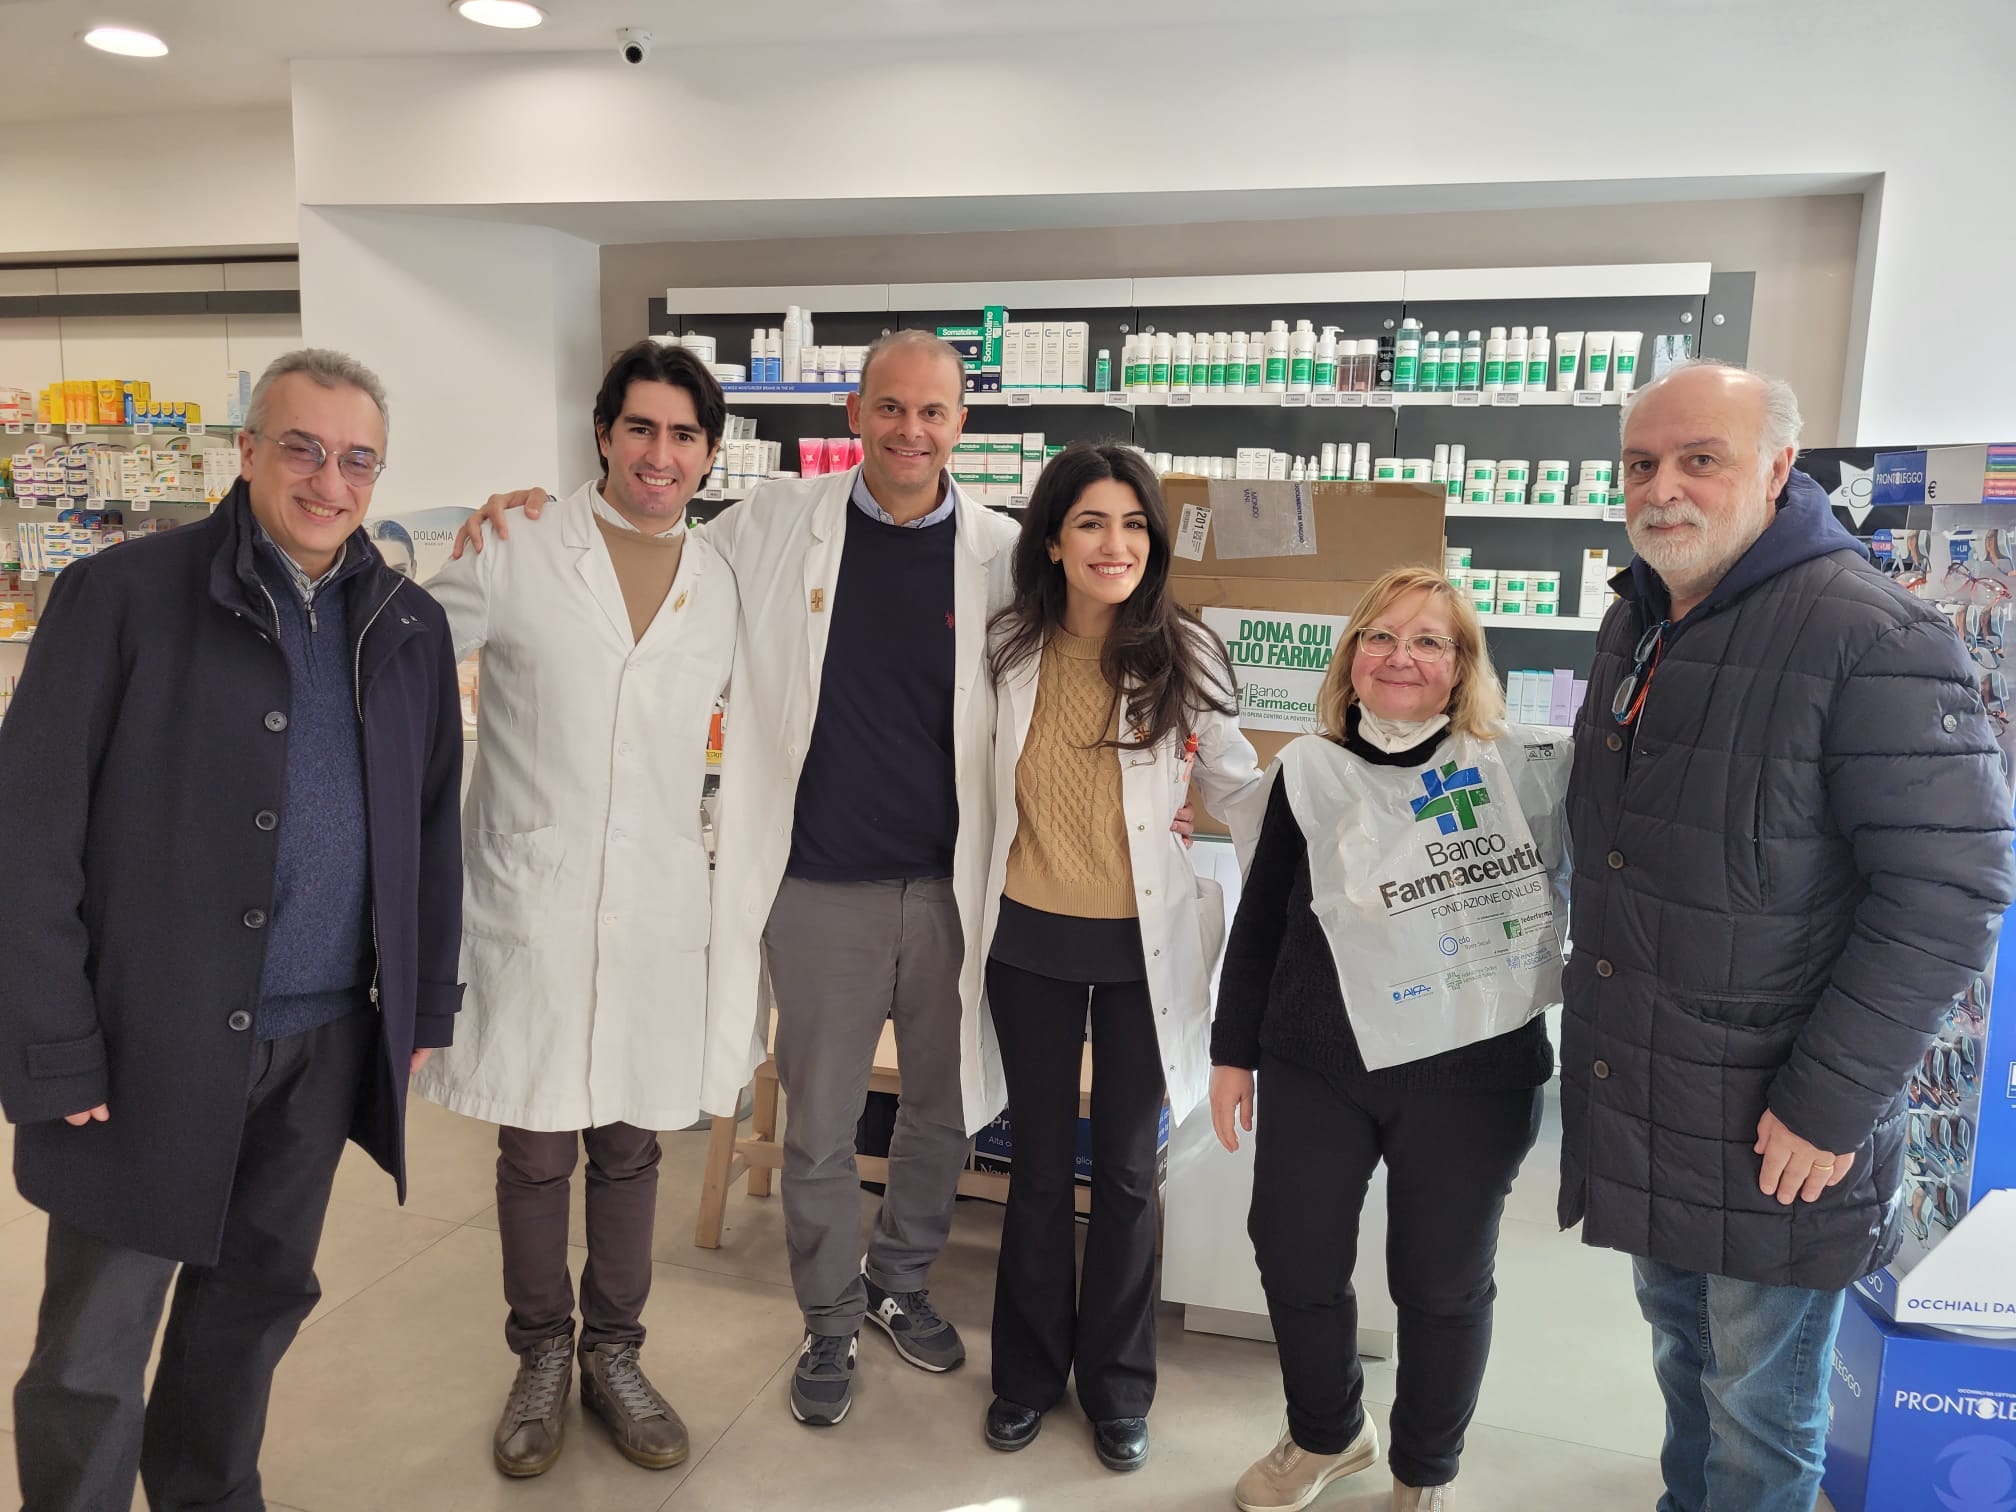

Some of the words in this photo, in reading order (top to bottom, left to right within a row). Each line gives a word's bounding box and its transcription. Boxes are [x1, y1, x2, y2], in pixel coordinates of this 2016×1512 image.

[942, 328, 979, 336] Somatoline
[983, 311, 993, 362] Somatoline
[1928, 480, 1938, 499] €
[413, 530, 454, 541] DOLOMIA
[1239, 619, 1294, 645] DONA
[1299, 623, 1332, 647] QUI
[1226, 641, 1264, 664] TUO
[1249, 683, 1289, 699] Banco
[1248, 695, 1316, 713] Farmaceu
[1424, 833, 1506, 867] Banco
[1431, 891, 1501, 920] FONDAZIONE
[1501, 880, 1542, 901] ONLUS
[1520, 910, 1553, 925] federfarma
[1907, 1298, 1988, 1313] OCCHIALI
